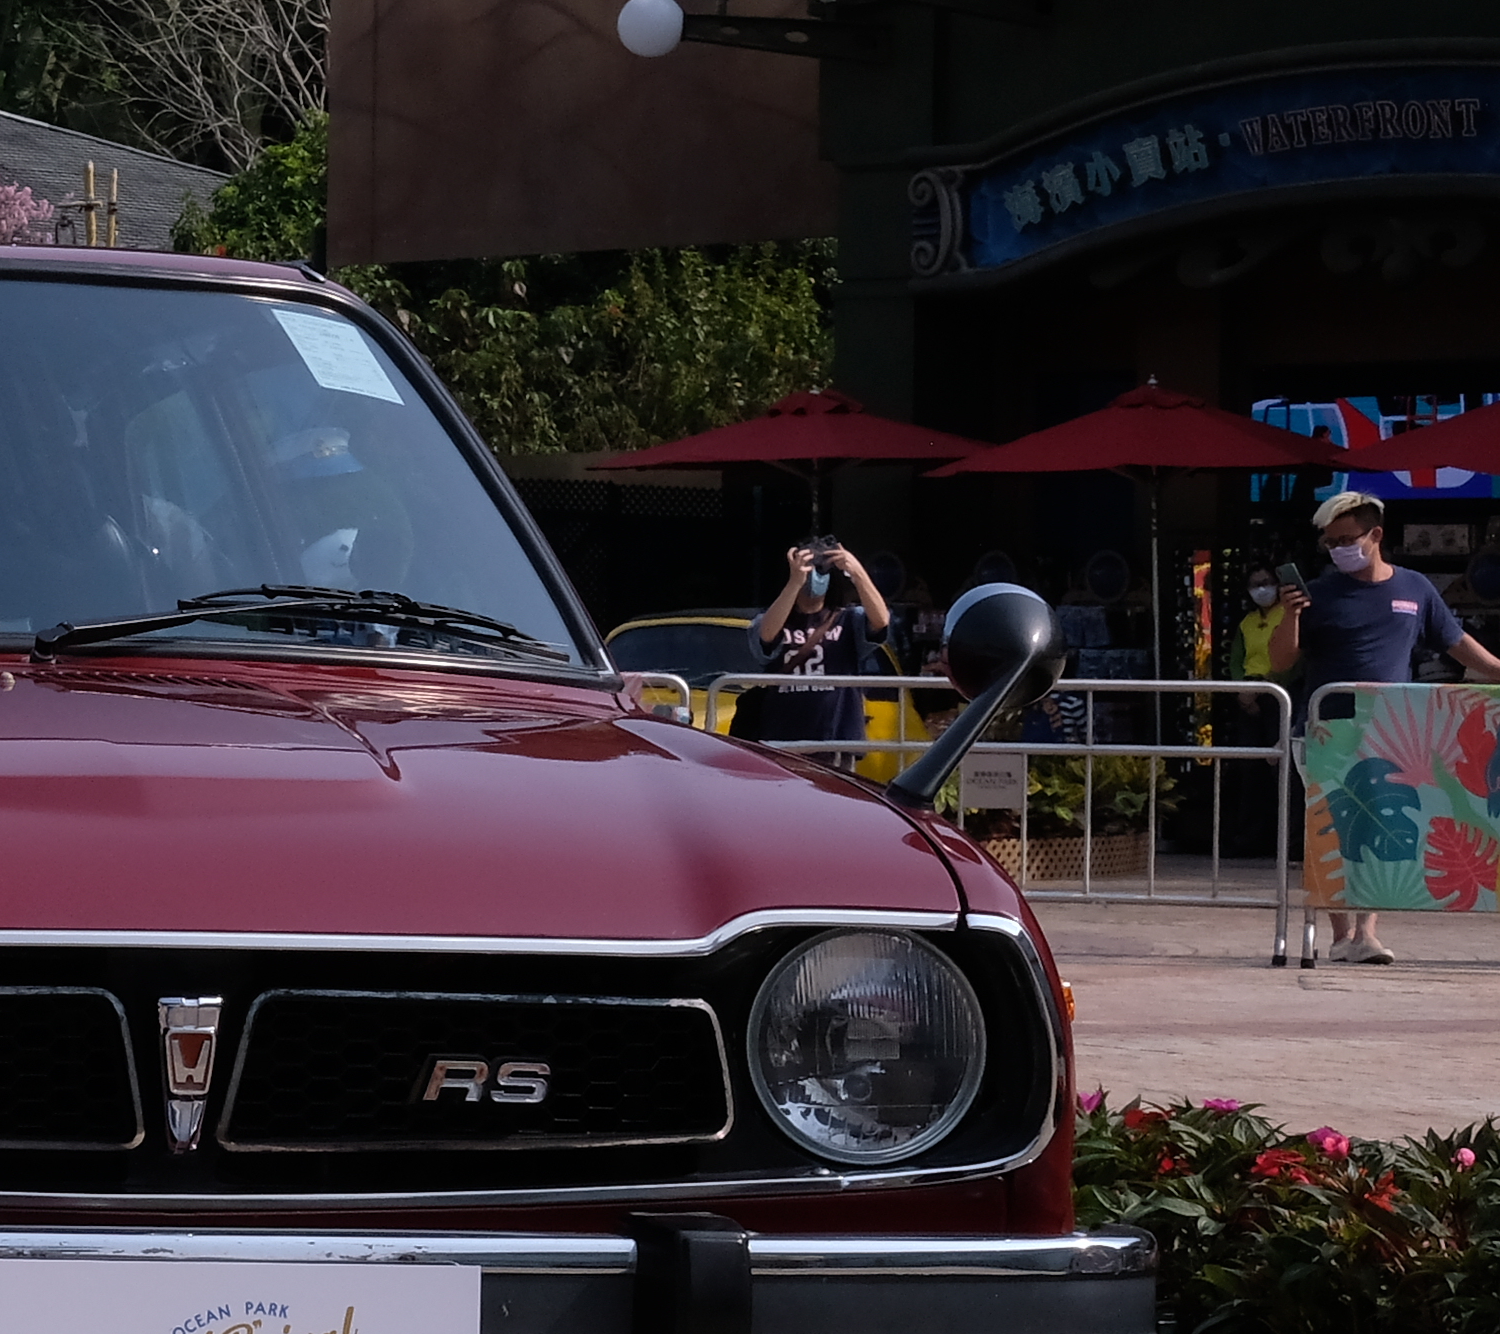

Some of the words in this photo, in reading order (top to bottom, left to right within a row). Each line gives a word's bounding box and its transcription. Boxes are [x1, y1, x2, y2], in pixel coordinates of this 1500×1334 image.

[1239, 97, 1480, 156] WATERFRONT
[422, 1059, 552, 1105] RS
[245, 1301, 289, 1319] PARK
